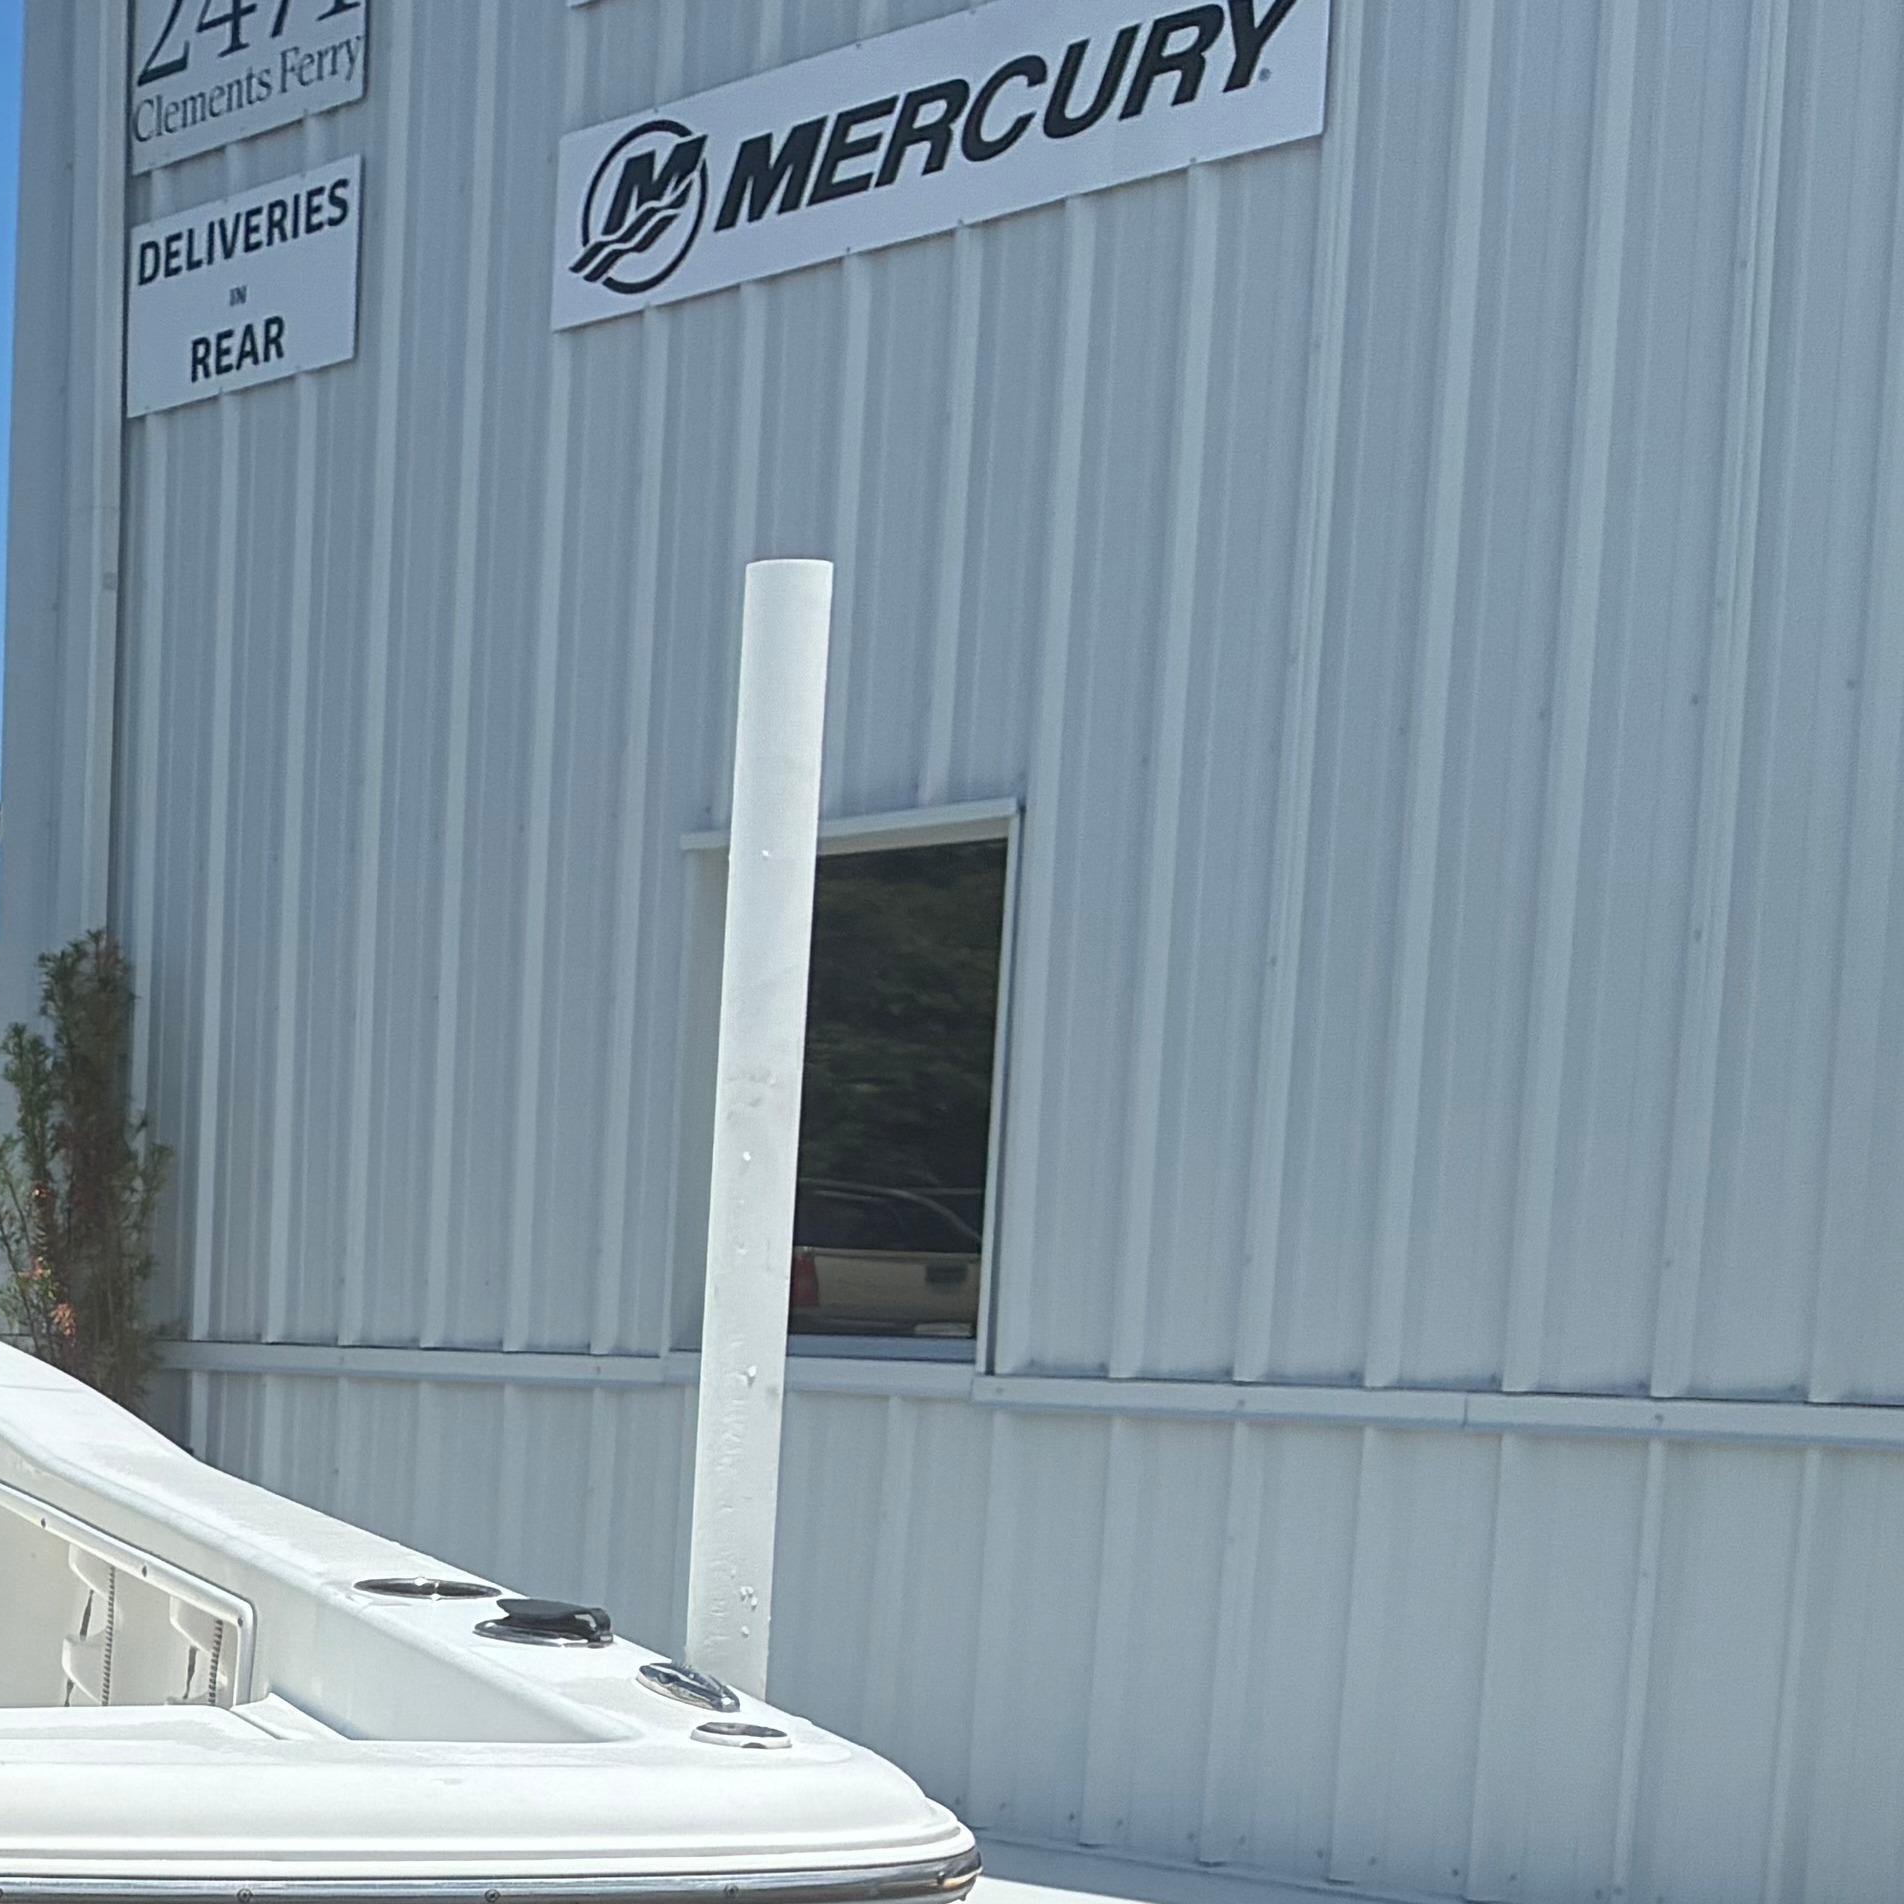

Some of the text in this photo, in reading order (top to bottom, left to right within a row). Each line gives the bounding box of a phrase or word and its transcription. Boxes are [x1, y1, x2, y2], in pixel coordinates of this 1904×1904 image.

[133, 35, 363, 142] Clements Ferry
[712, 0, 1294, 233] MERCURY
[138, 178, 349, 286] DELIVERIES
[191, 315, 284, 383] REAR
[229, 285, 247, 306] IN
